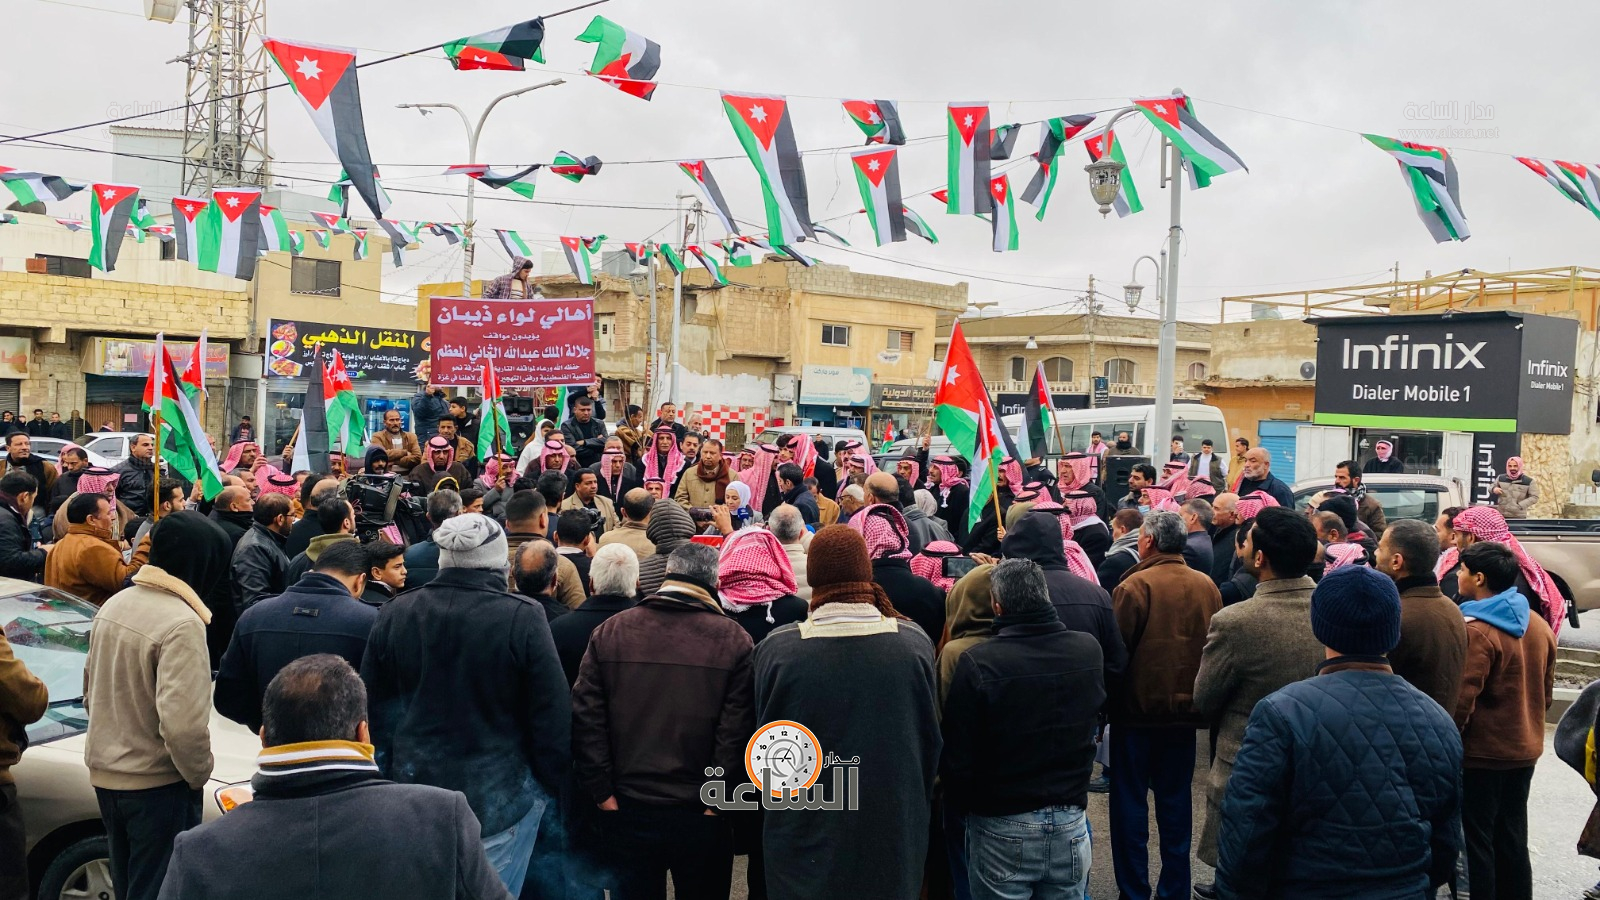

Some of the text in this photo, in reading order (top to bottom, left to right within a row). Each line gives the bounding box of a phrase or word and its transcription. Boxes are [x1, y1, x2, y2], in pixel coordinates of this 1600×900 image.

[437, 304, 592, 329] أهالي لواء ذيبان
[301, 328, 415, 350] المنقل الذهبي
[511, 333, 540, 341] يؤيدون
[437, 344, 467, 360] المعظم
[469, 343, 501, 364] الثاني
[542, 346, 563, 358] الملك
[566, 344, 591, 359] جلالة
[1342, 333, 1487, 370] Infinix
[554, 363, 563, 371] الله
[1527, 359, 1569, 378] Infinix
[437, 373, 450, 382] غزة
[540, 374, 571, 382] الفلسطينية
[1530, 380, 1545, 389] Dialer
[1546, 381, 1561, 391] Mobile
[1352, 384, 1471, 402] Dialer Mobile 1
[1476, 443, 1496, 506] Infini
